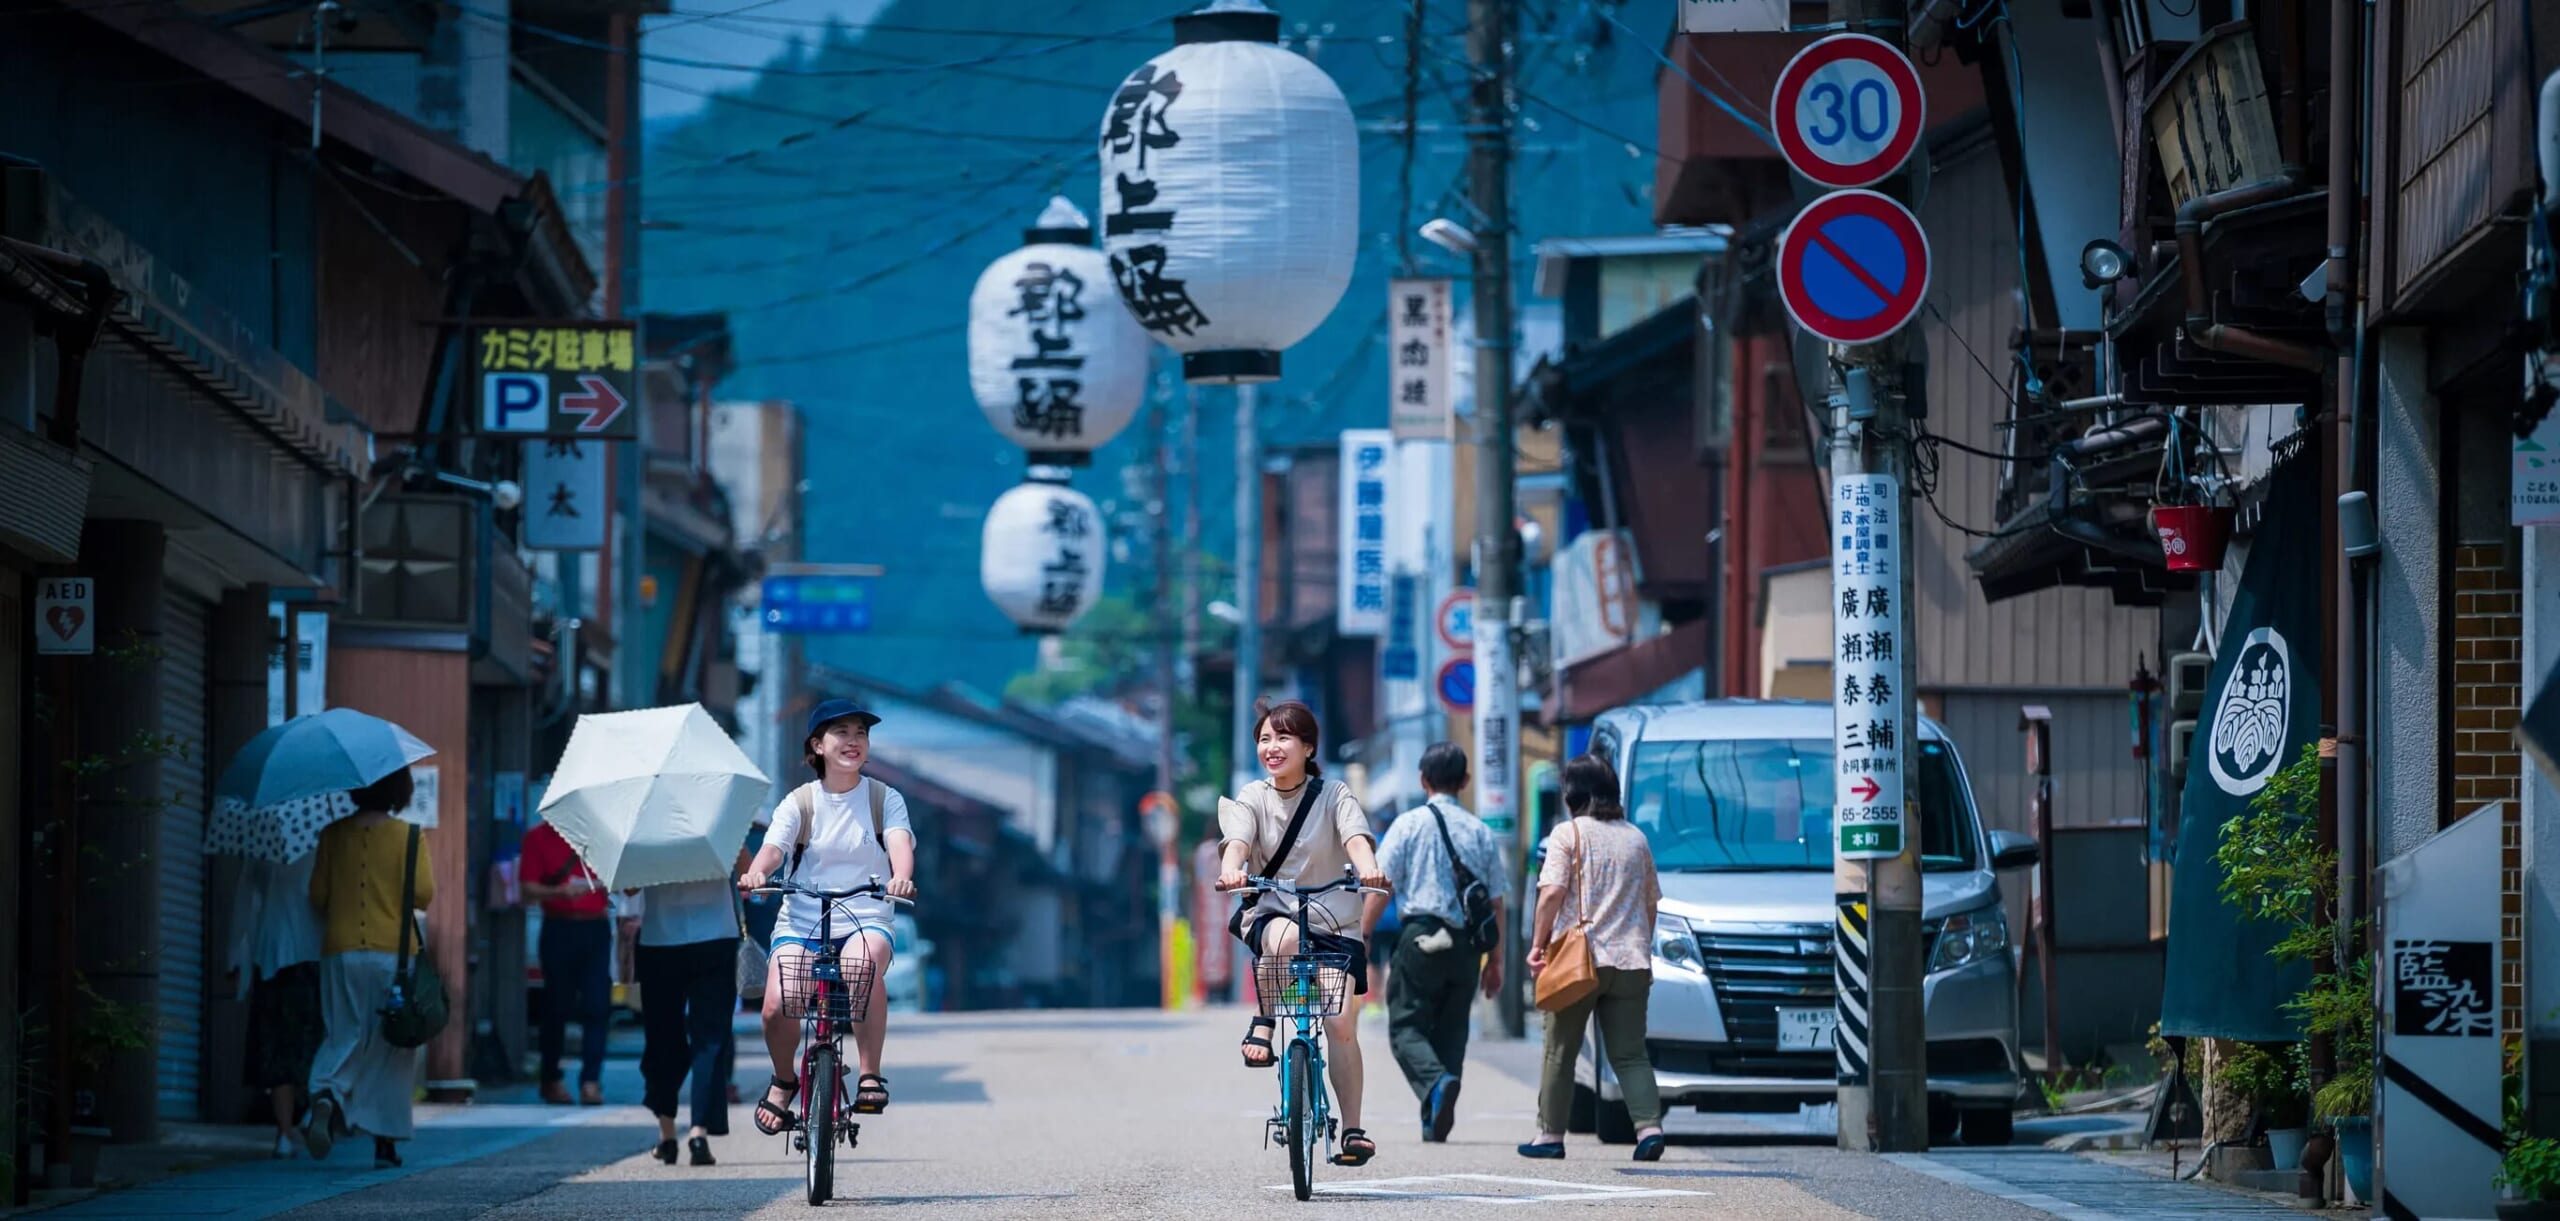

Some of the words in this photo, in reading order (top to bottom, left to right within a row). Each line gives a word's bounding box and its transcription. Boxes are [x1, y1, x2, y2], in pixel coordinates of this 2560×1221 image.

[1808, 78, 1889, 146] 30
[481, 328, 633, 371] カミタ駐車場
[495, 377, 542, 429] P
[1841, 484, 1853, 576] 行政書士
[1874, 482, 1889, 575] 司法書士
[46, 582, 86, 600] AED
[1842, 757, 1897, 775] 合同事務所
[1842, 806, 1898, 822] 65-2555
[1851, 831, 1880, 847] 本町
[2394, 939, 2494, 1038] 藍染
